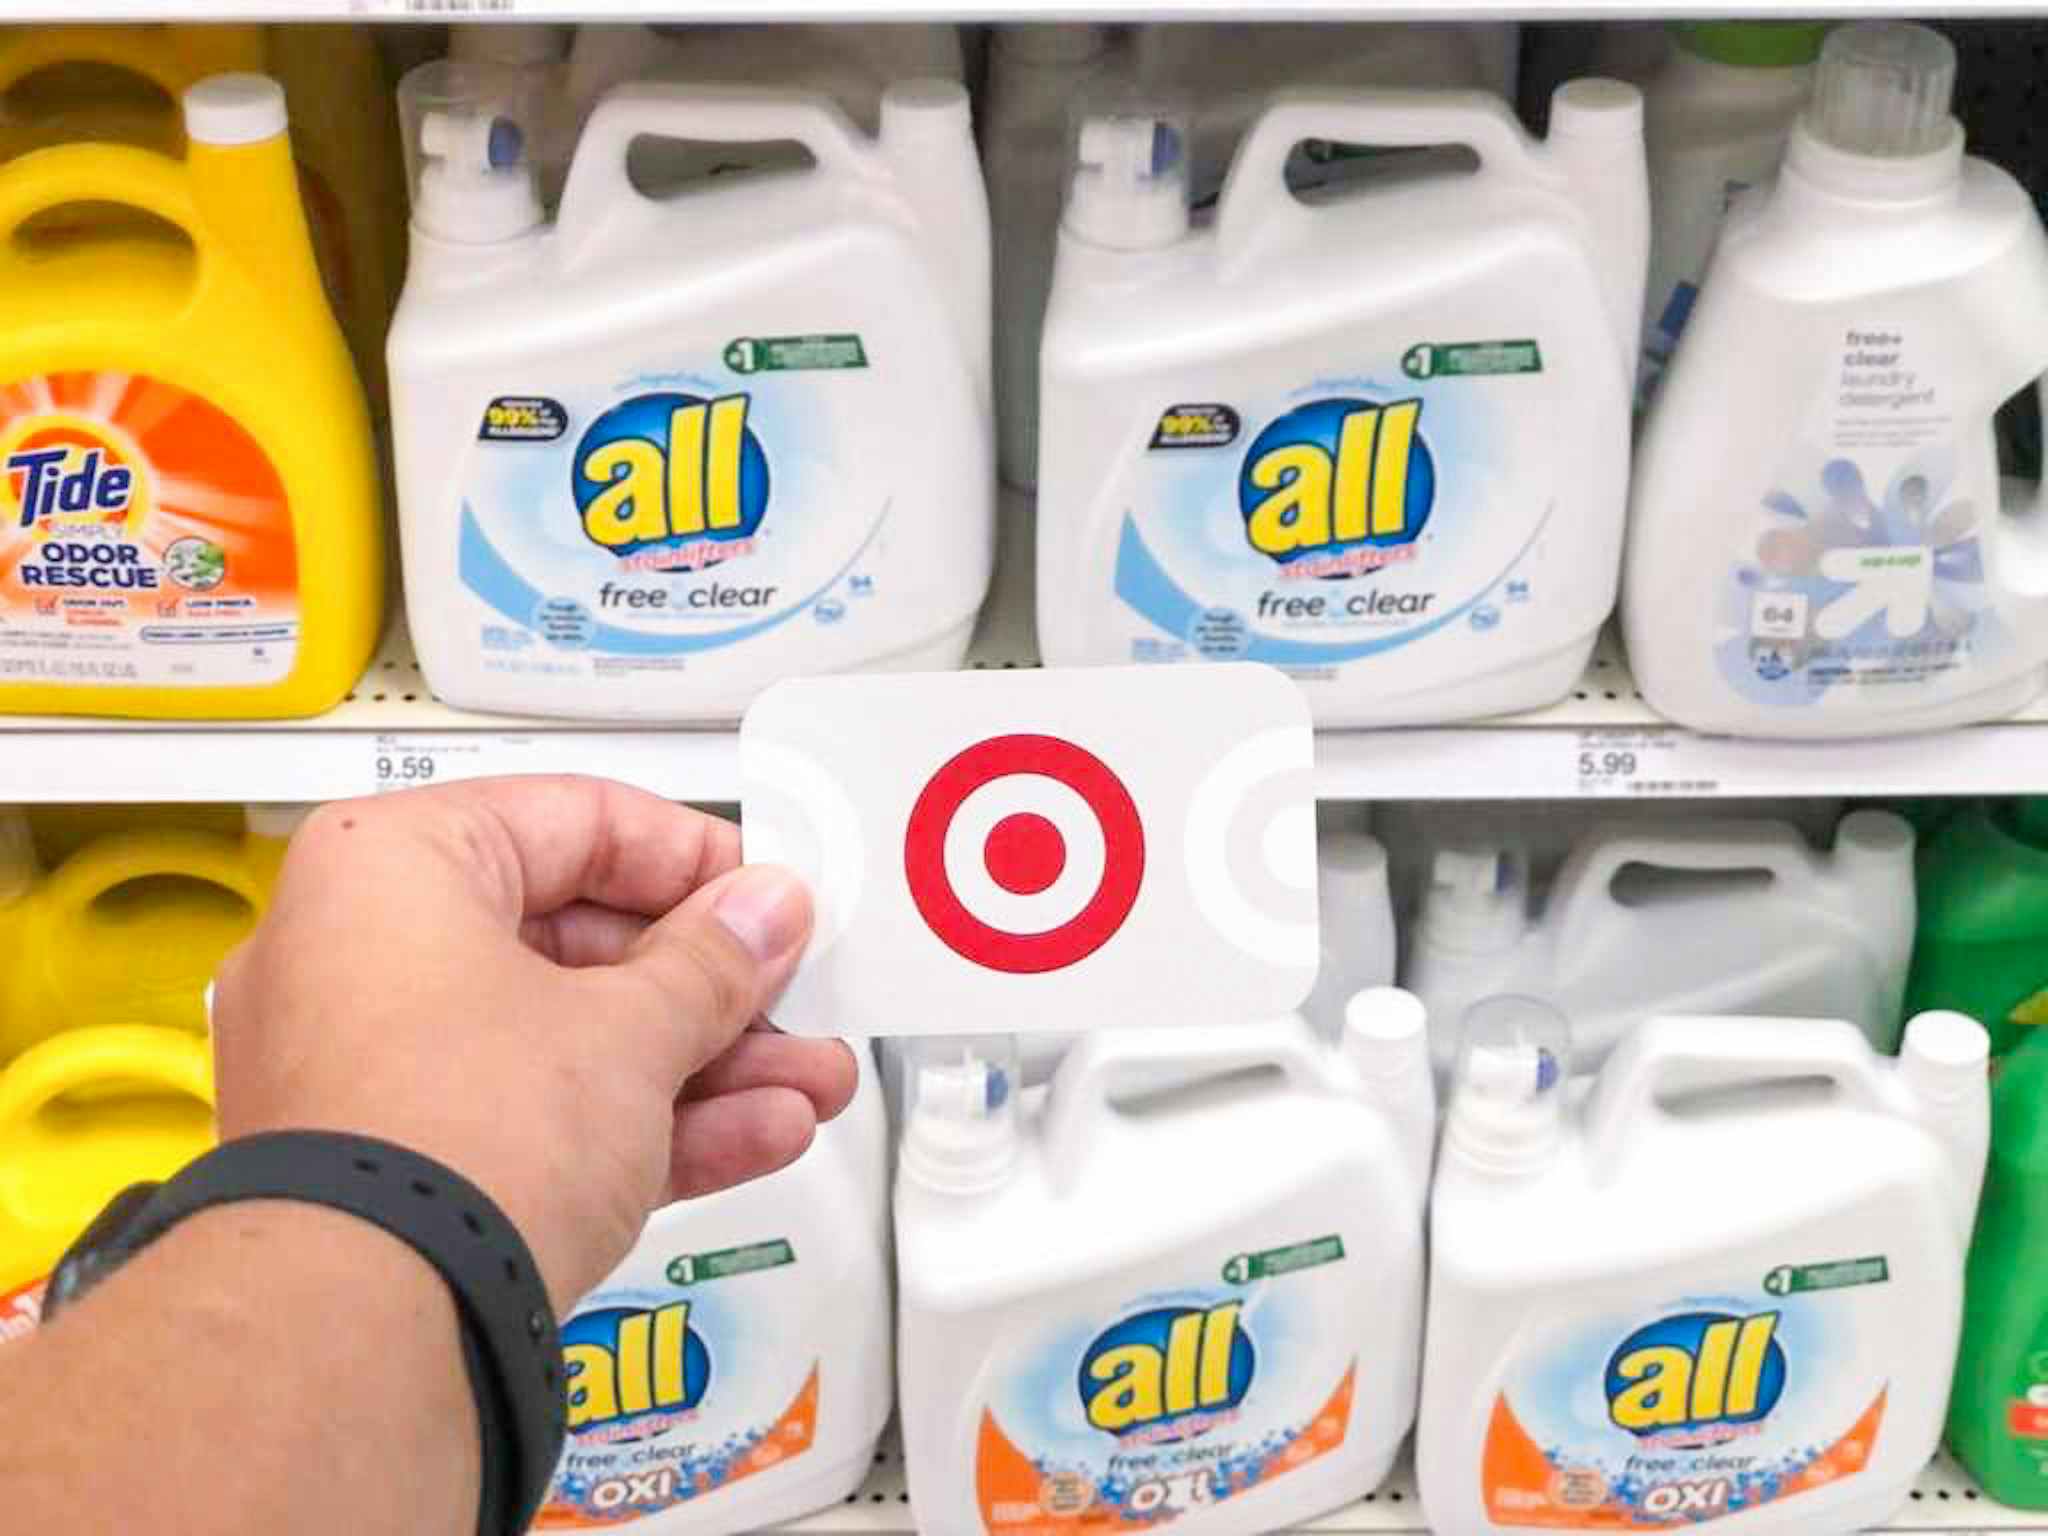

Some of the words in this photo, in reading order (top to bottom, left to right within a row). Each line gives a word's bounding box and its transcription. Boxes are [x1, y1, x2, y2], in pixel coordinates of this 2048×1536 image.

[7, 449, 132, 529] Tide
[581, 393, 750, 548] all
[1248, 397, 1424, 556] all
[41, 542, 140, 566] ODOR
[21, 564, 158, 589] RESCUE
[598, 581, 668, 612] free
[687, 580, 778, 609] clear
[1257, 588, 1326, 619] free
[1346, 588, 1436, 616] clear
[375, 755, 435, 780] 9.59
[1577, 751, 1637, 776] 5.99
[1087, 1299, 1243, 1436] all
[1609, 1311, 1780, 1438] all
[590, 1470, 675, 1509] OXI
[1644, 1477, 1729, 1514] OXI
